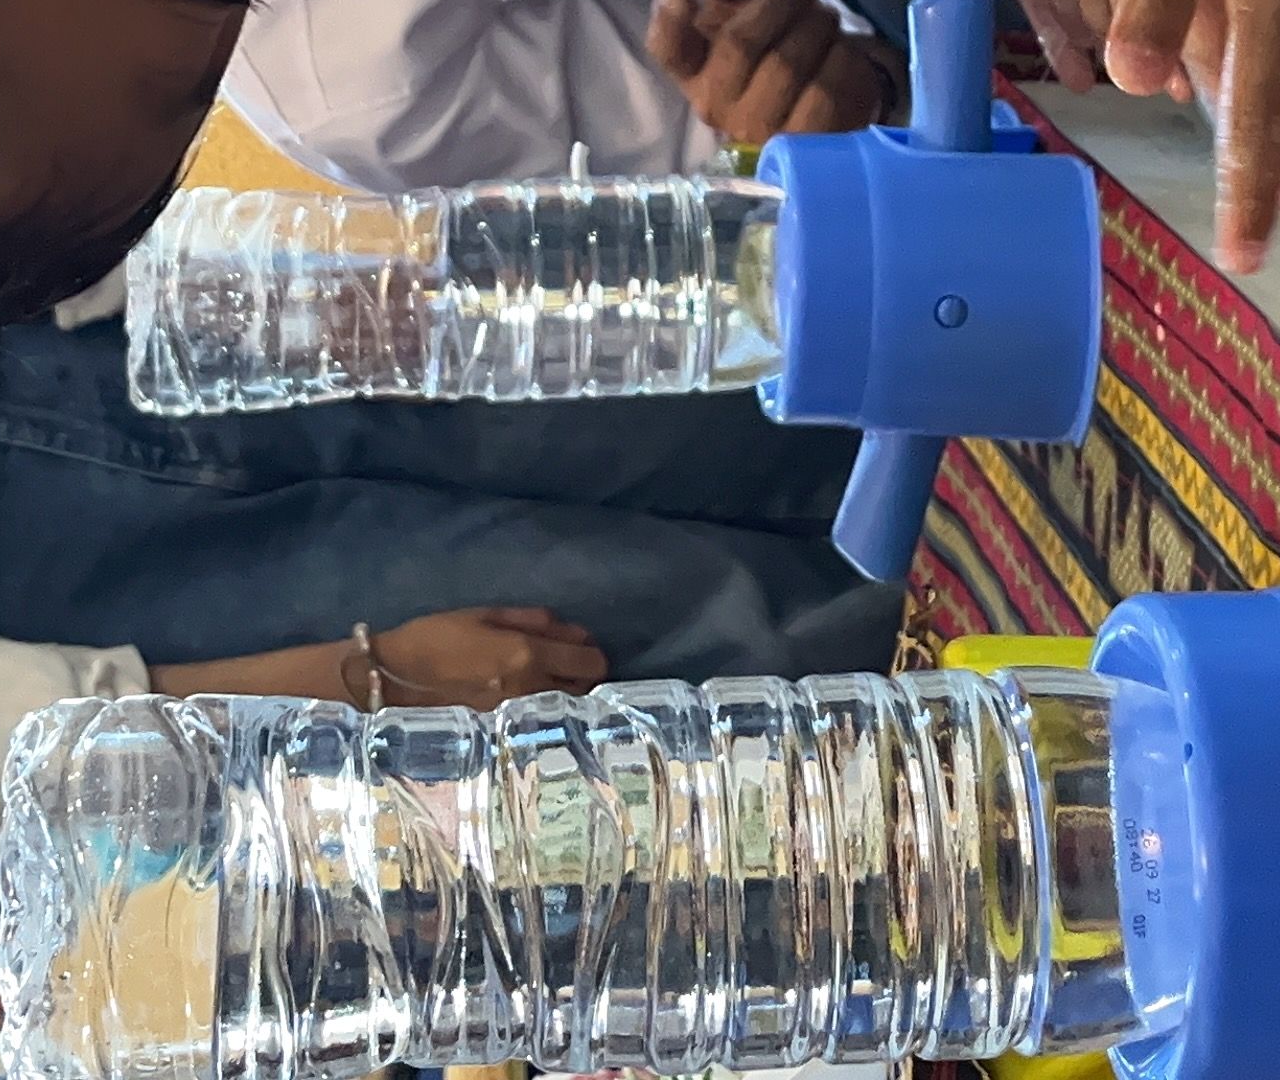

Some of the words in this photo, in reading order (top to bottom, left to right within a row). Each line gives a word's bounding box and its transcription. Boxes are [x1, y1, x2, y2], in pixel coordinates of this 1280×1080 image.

[1124, 818, 1144, 873] 08:40
[1145, 859, 1159, 879] 09
[1147, 887, 1161, 905] 27
